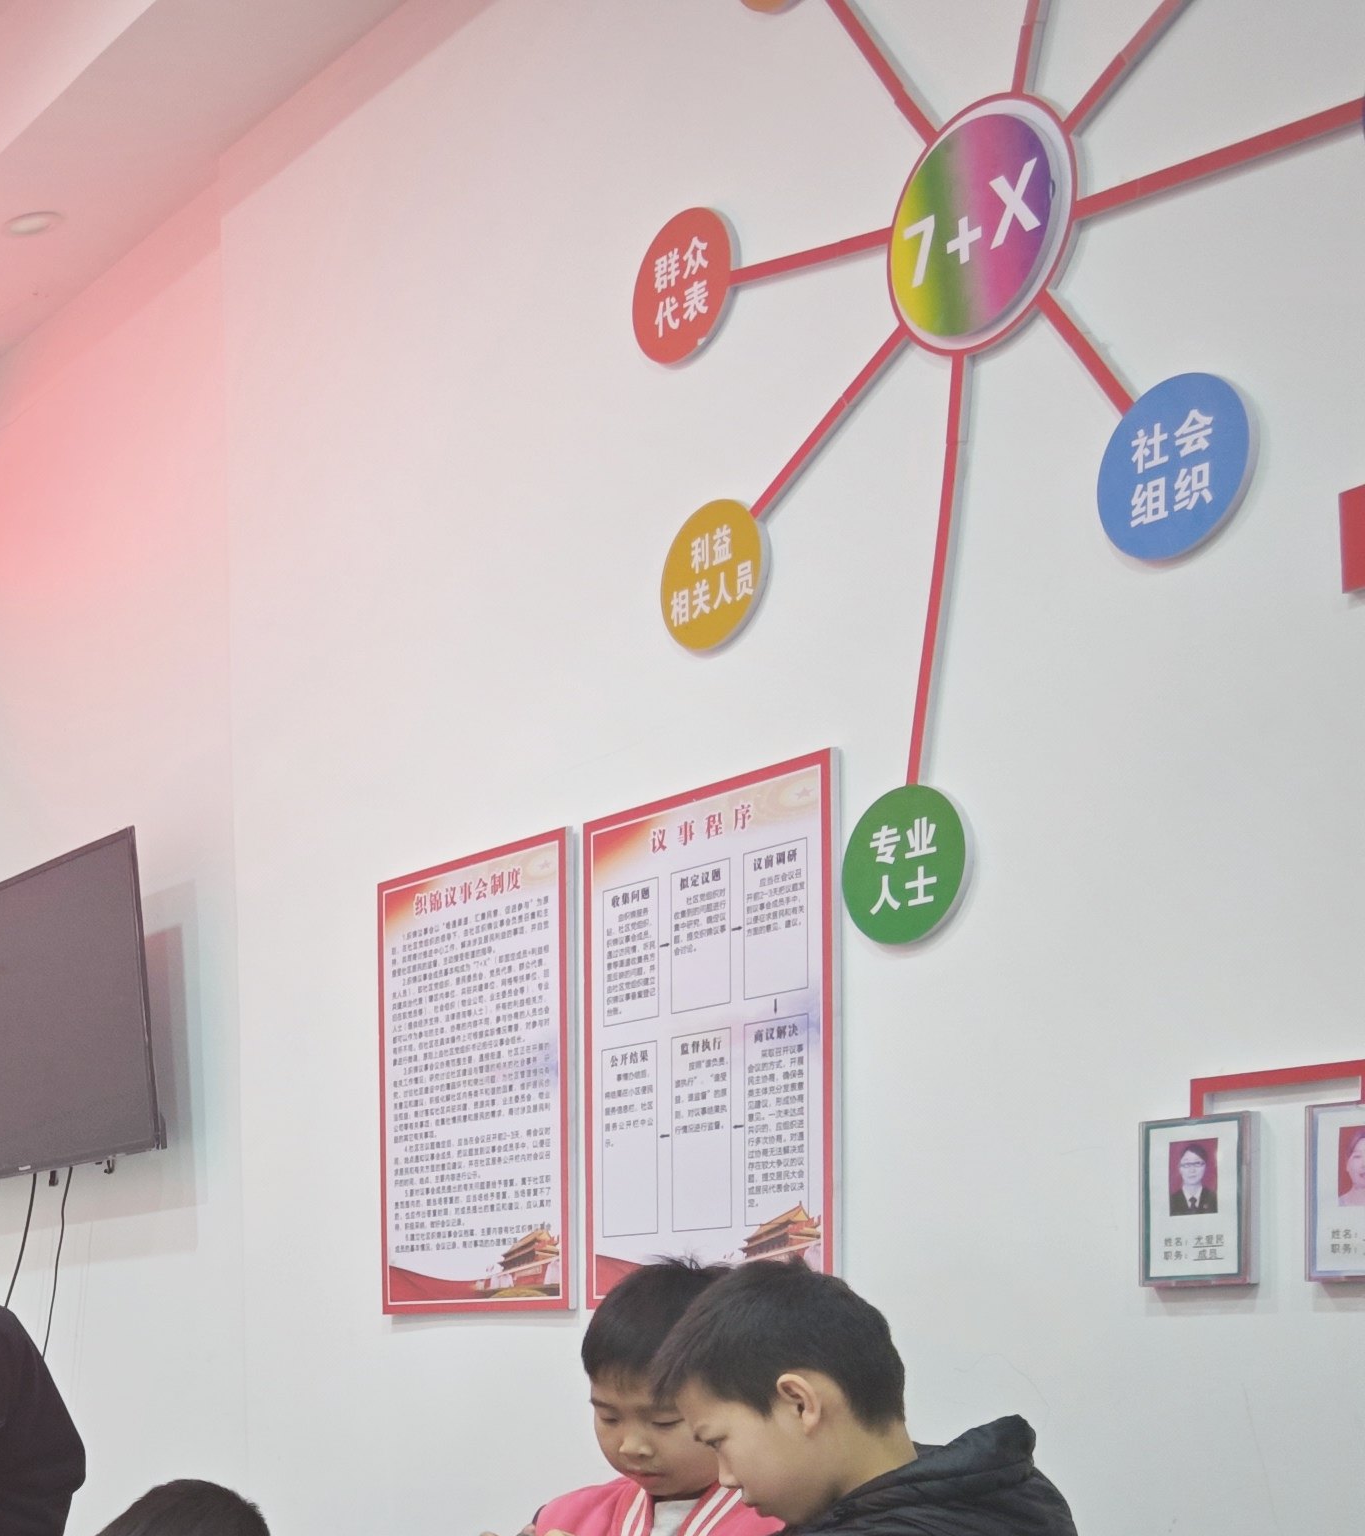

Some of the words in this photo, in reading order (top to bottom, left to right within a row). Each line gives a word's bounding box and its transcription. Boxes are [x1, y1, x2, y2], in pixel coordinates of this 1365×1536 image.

[901, 157, 1043, 288] 7+X
[652, 234, 709, 294] 群众
[654, 280, 709, 339] 代表
[1130, 408, 1214, 474] 社会
[1129, 467, 1212, 528] 组织
[691, 525, 733, 570] 利益
[670, 560, 755, 628] 相关人员
[651, 804, 753, 854] 议事程序
[869, 816, 938, 866] 专业
[680, 868, 722, 891] 拟定议题
[753, 848, 798, 872] 议前调研
[414, 866, 522, 917] 织锦议事会制度
[611, 886, 650, 908] 收集问题
[869, 866, 938, 916] 人士
[610, 1050, 649, 1068] 公开结果
[680, 1036, 722, 1056] 监督执行
[754, 1024, 798, 1044] 商议解决
